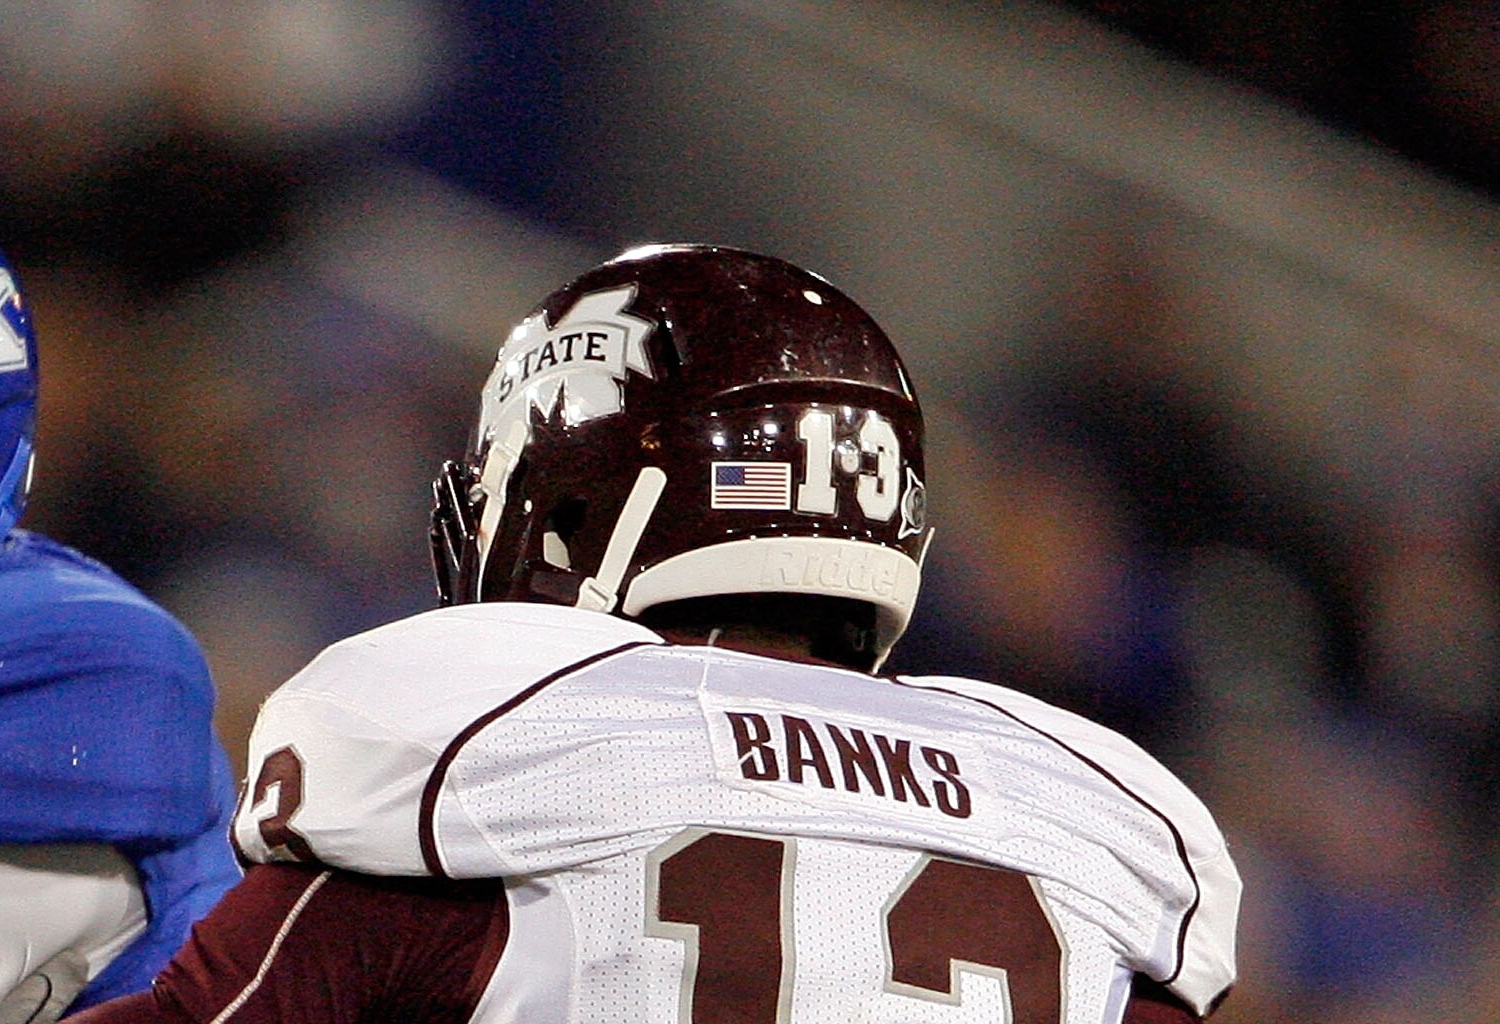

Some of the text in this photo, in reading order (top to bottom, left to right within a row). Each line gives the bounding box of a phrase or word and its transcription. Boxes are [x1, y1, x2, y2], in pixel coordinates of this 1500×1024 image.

[498, 332, 609, 403] STATE
[796, 408, 901, 523] 13
[759, 546, 908, 606] Riddel
[725, 711, 972, 820] BANKS
